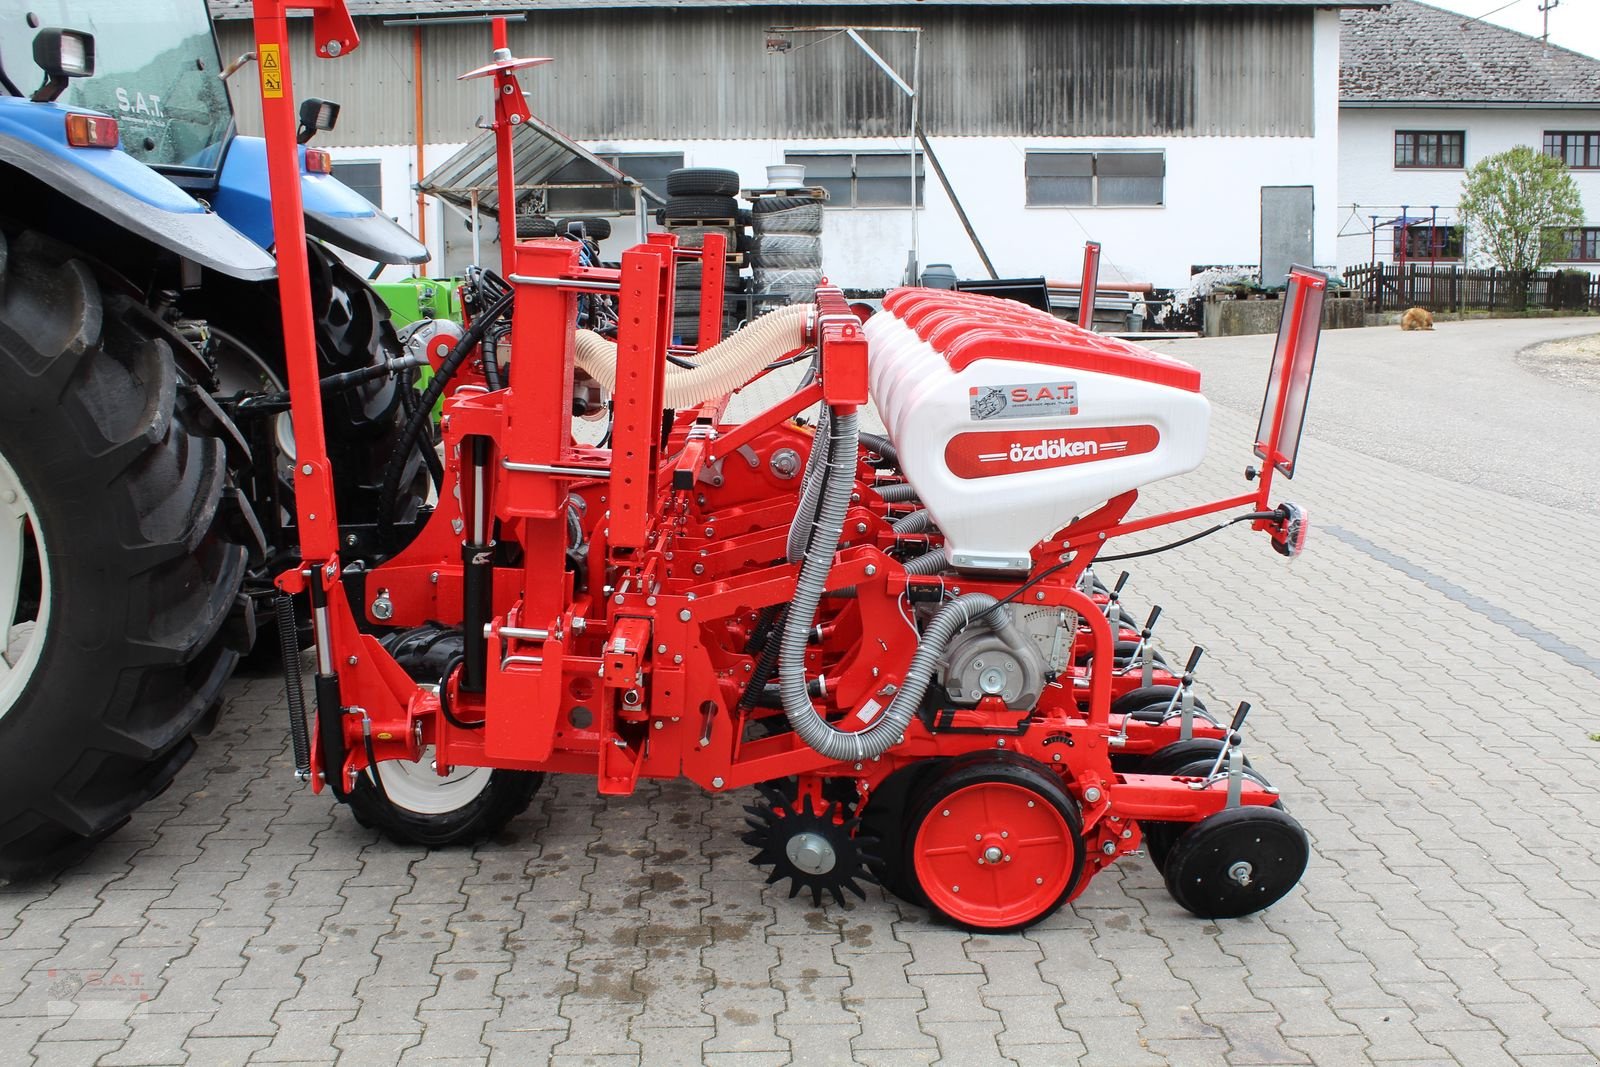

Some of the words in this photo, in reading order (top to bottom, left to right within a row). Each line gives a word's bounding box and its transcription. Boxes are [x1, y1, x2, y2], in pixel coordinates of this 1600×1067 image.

[116, 87, 164, 118] S.A.T.
[1011, 385, 1074, 402] S.A.T.
[1009, 438, 1097, 462] özdöken
